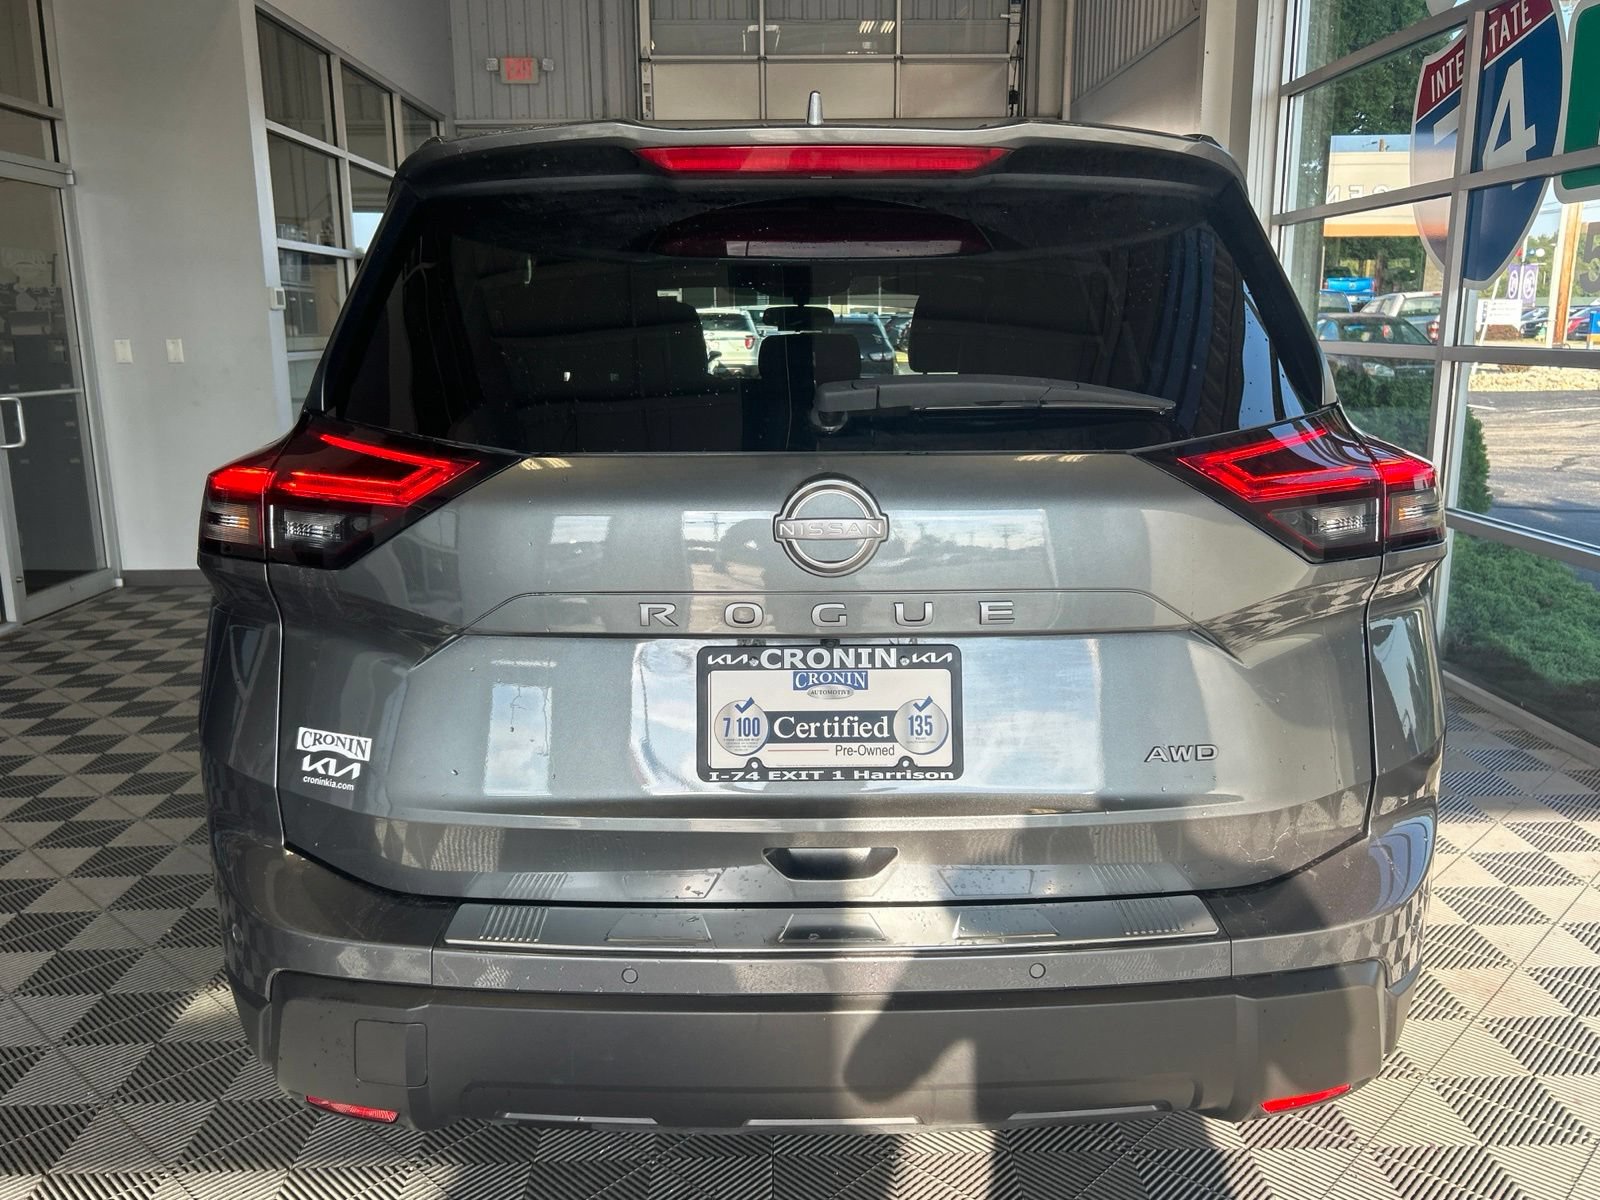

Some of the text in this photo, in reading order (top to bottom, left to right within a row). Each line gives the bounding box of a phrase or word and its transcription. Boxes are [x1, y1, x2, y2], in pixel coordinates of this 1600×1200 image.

[779, 521, 883, 537] NISSAN
[638, 601, 1017, 628] ROGUE
[760, 648, 897, 669] CRONIN
[795, 672, 867, 689] CRONIN
[723, 717, 761, 737] 7 100
[773, 715, 890, 739] Certified
[907, 715, 934, 736] 135
[301, 730, 369, 759] CRONIN
[835, 744, 895, 757] Pre-Owned
[1143, 744, 1220, 762] AWD
[301, 754, 361, 780] KIA
[709, 770, 954, 781] I-74 EXIT 1 Harrison
[303, 775, 354, 791] croninkia.com
